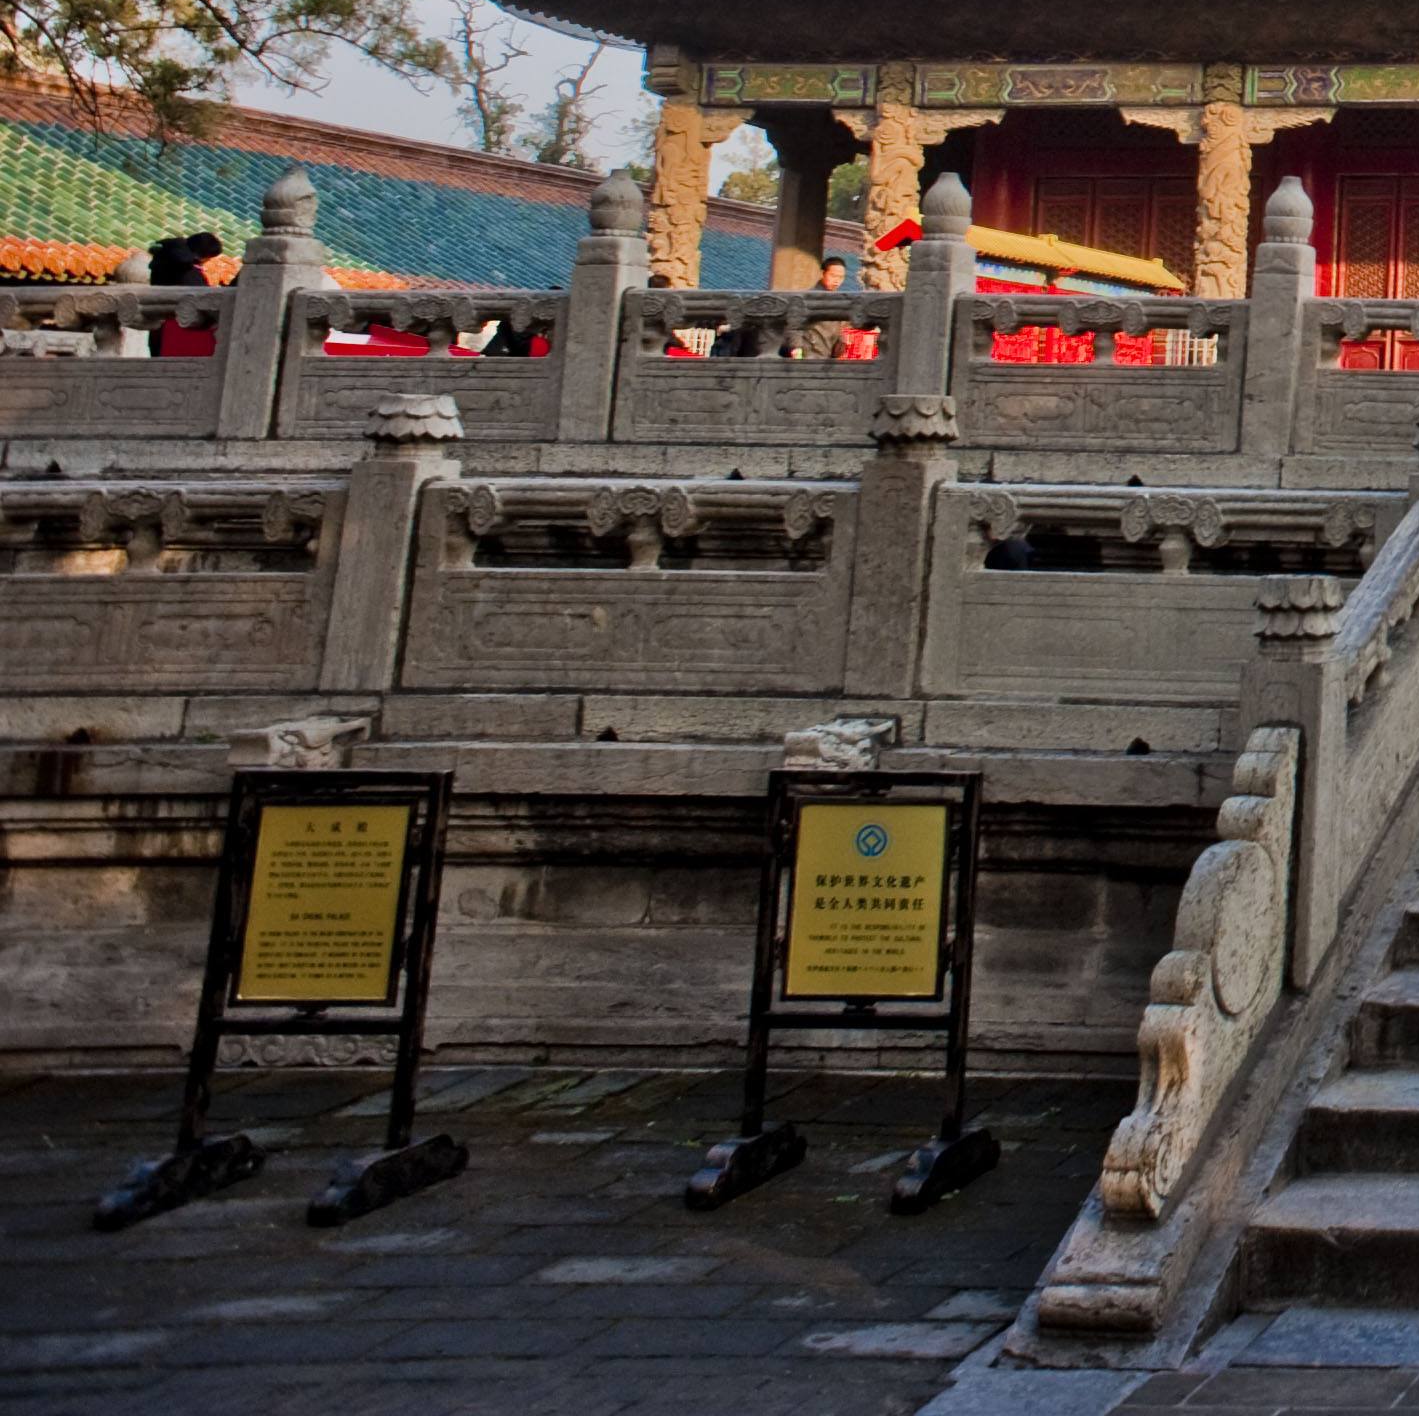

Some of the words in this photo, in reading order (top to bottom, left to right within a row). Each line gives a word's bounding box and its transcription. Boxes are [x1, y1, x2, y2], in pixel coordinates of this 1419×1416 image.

[815, 874, 926, 889] 保护世界文化遗产
[814, 896, 925, 911] 是全人类共同责任
